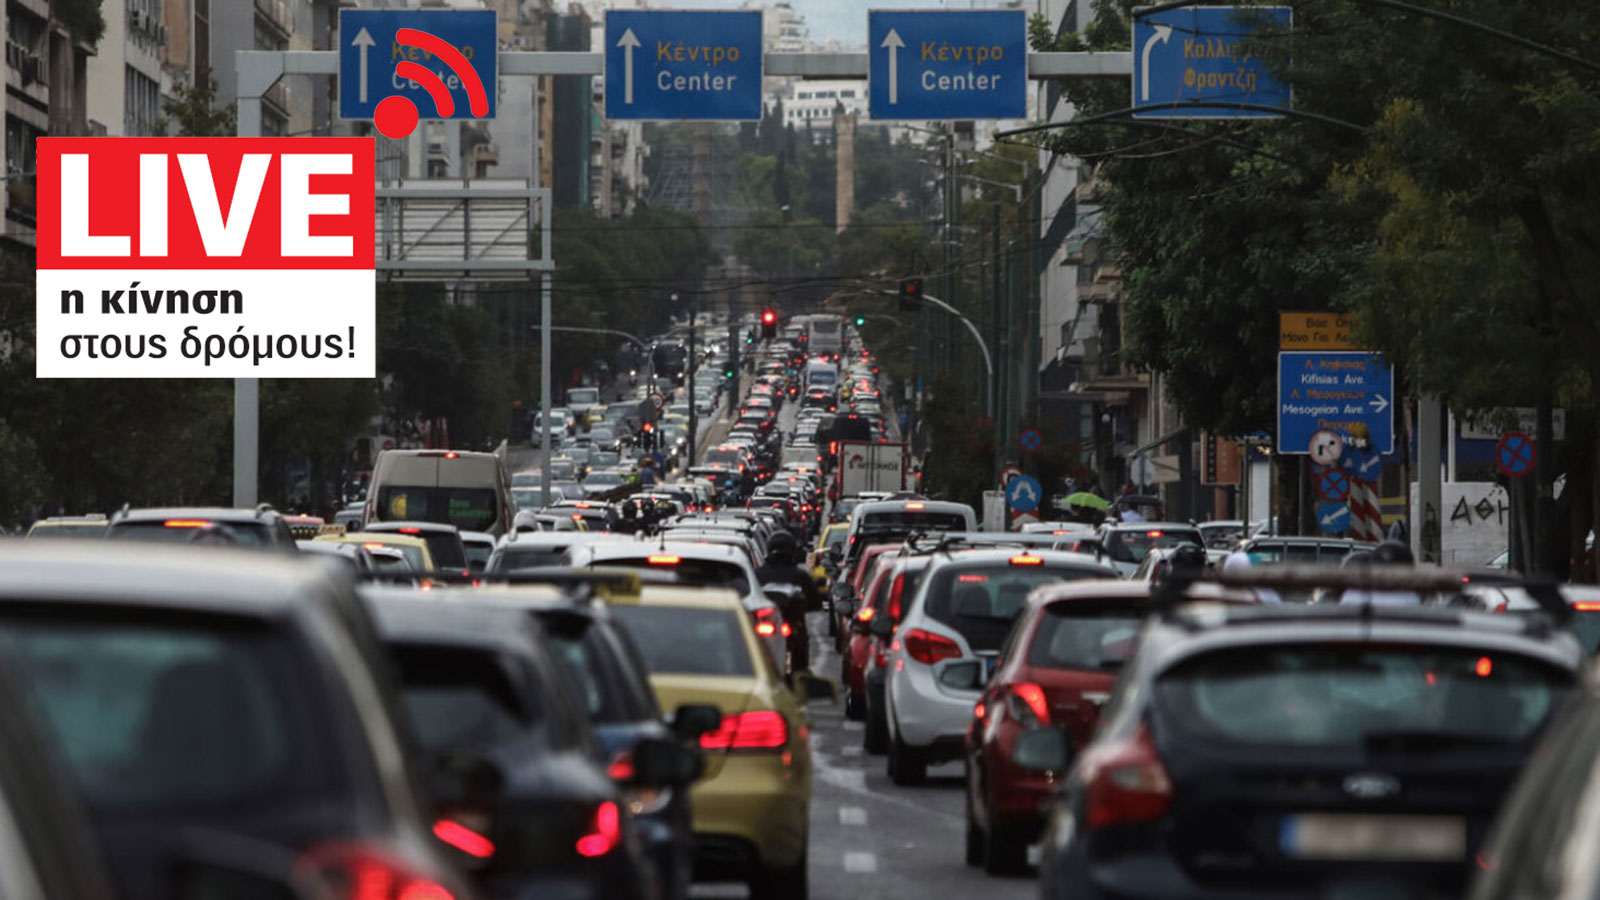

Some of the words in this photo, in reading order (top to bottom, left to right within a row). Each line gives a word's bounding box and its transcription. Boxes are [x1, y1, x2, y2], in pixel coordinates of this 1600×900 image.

[657, 41, 740, 66] Κέντρο
[921, 41, 1004, 66] Κέντρο
[657, 70, 737, 91] Center
[921, 70, 1001, 91] Center
[1301, 374, 1338, 385] Kifisias
[1282, 404, 1339, 417] Mesogeion
